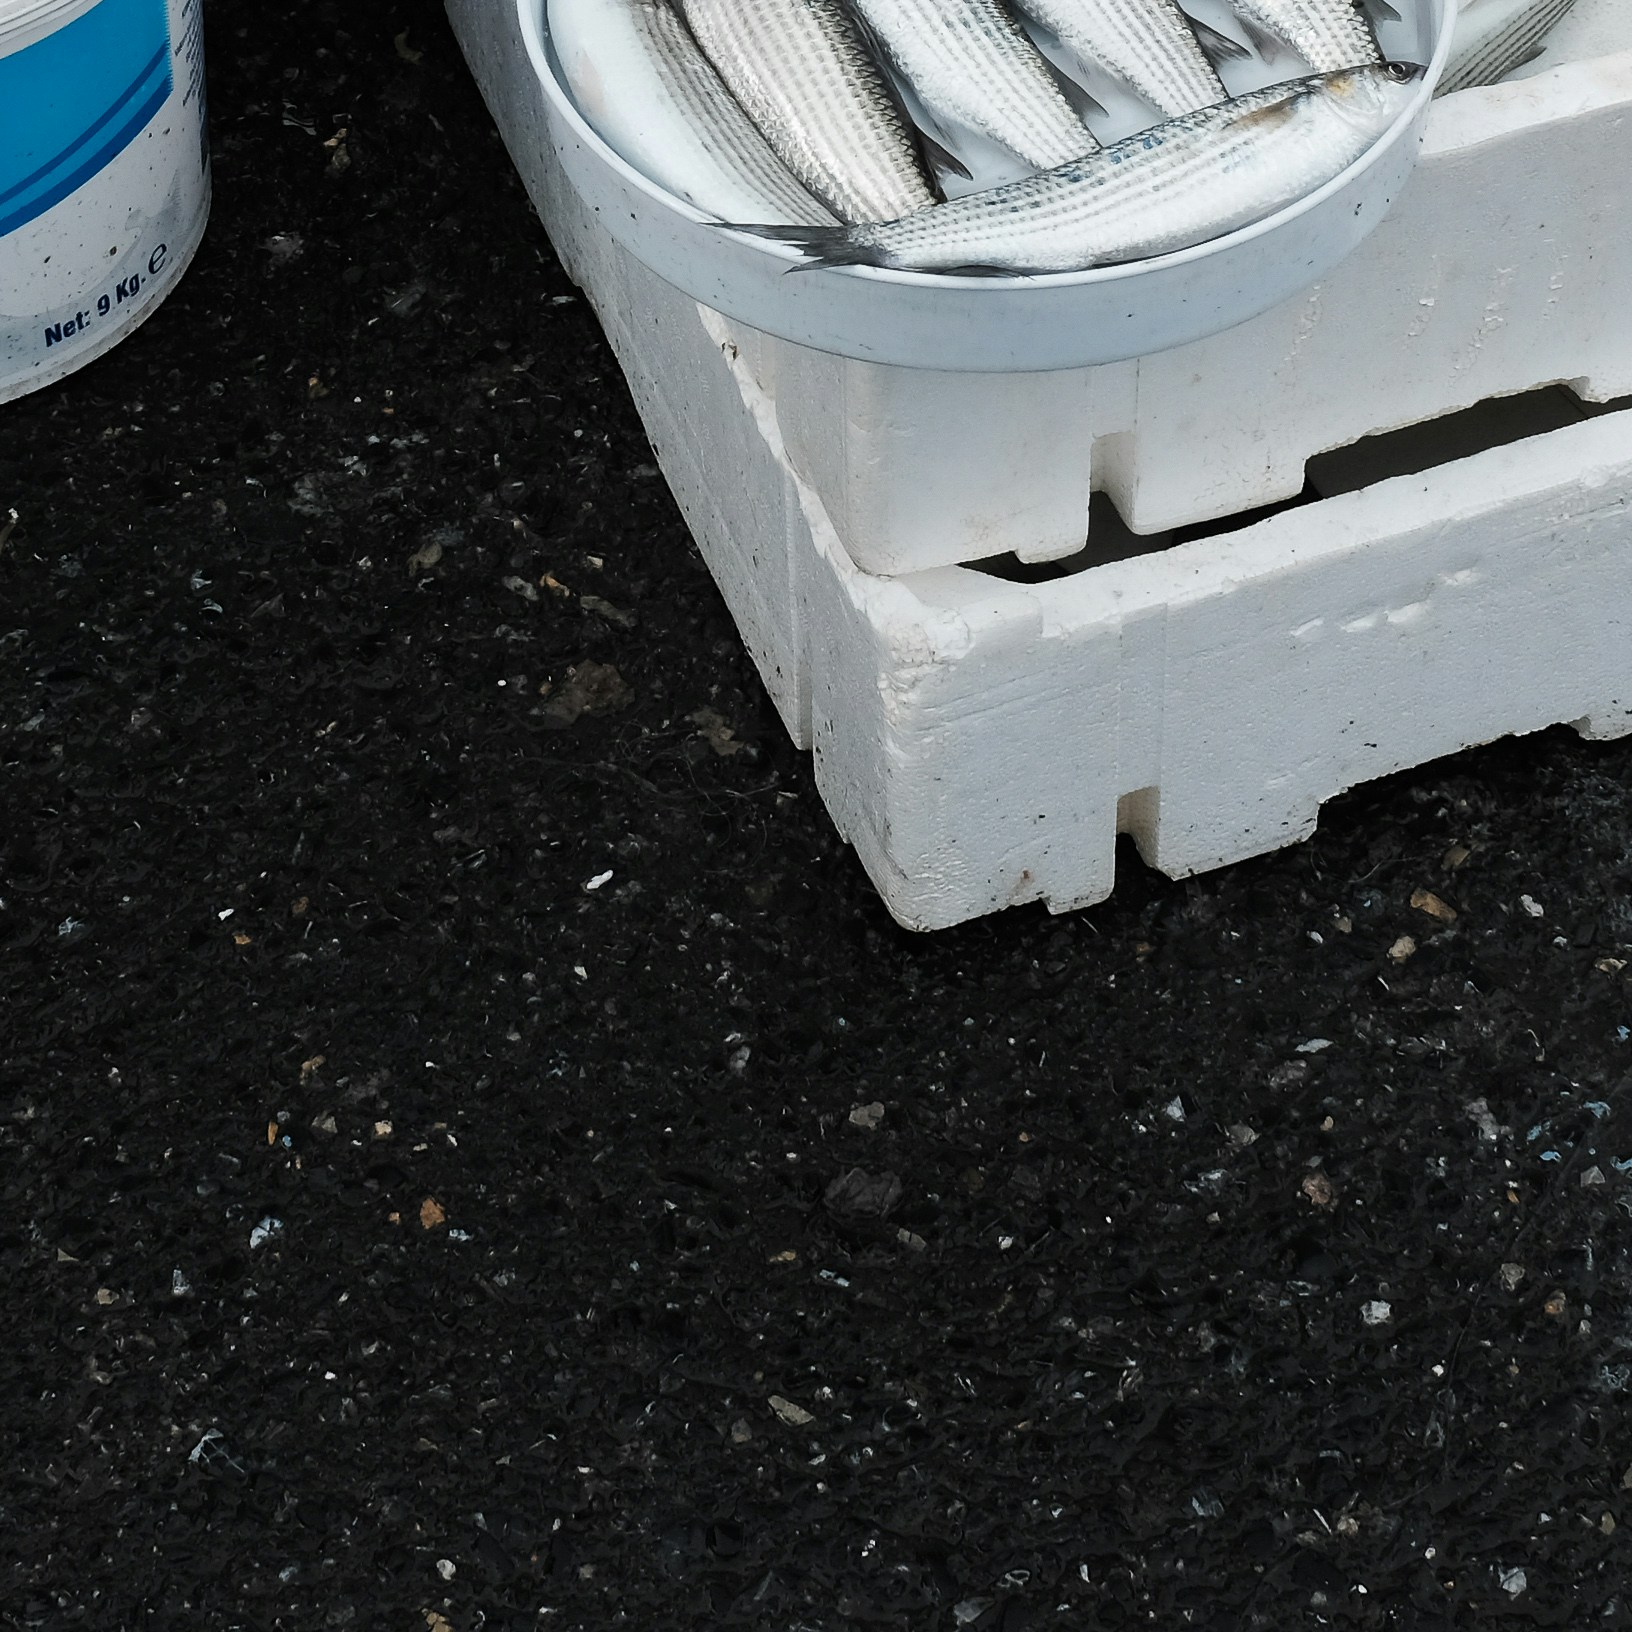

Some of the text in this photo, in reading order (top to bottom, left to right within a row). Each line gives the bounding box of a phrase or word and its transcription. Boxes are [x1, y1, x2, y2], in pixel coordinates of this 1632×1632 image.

[44, 310, 91, 348] Net:
[97, 293, 111, 317] 9
[115, 272, 146, 304] Kg.
